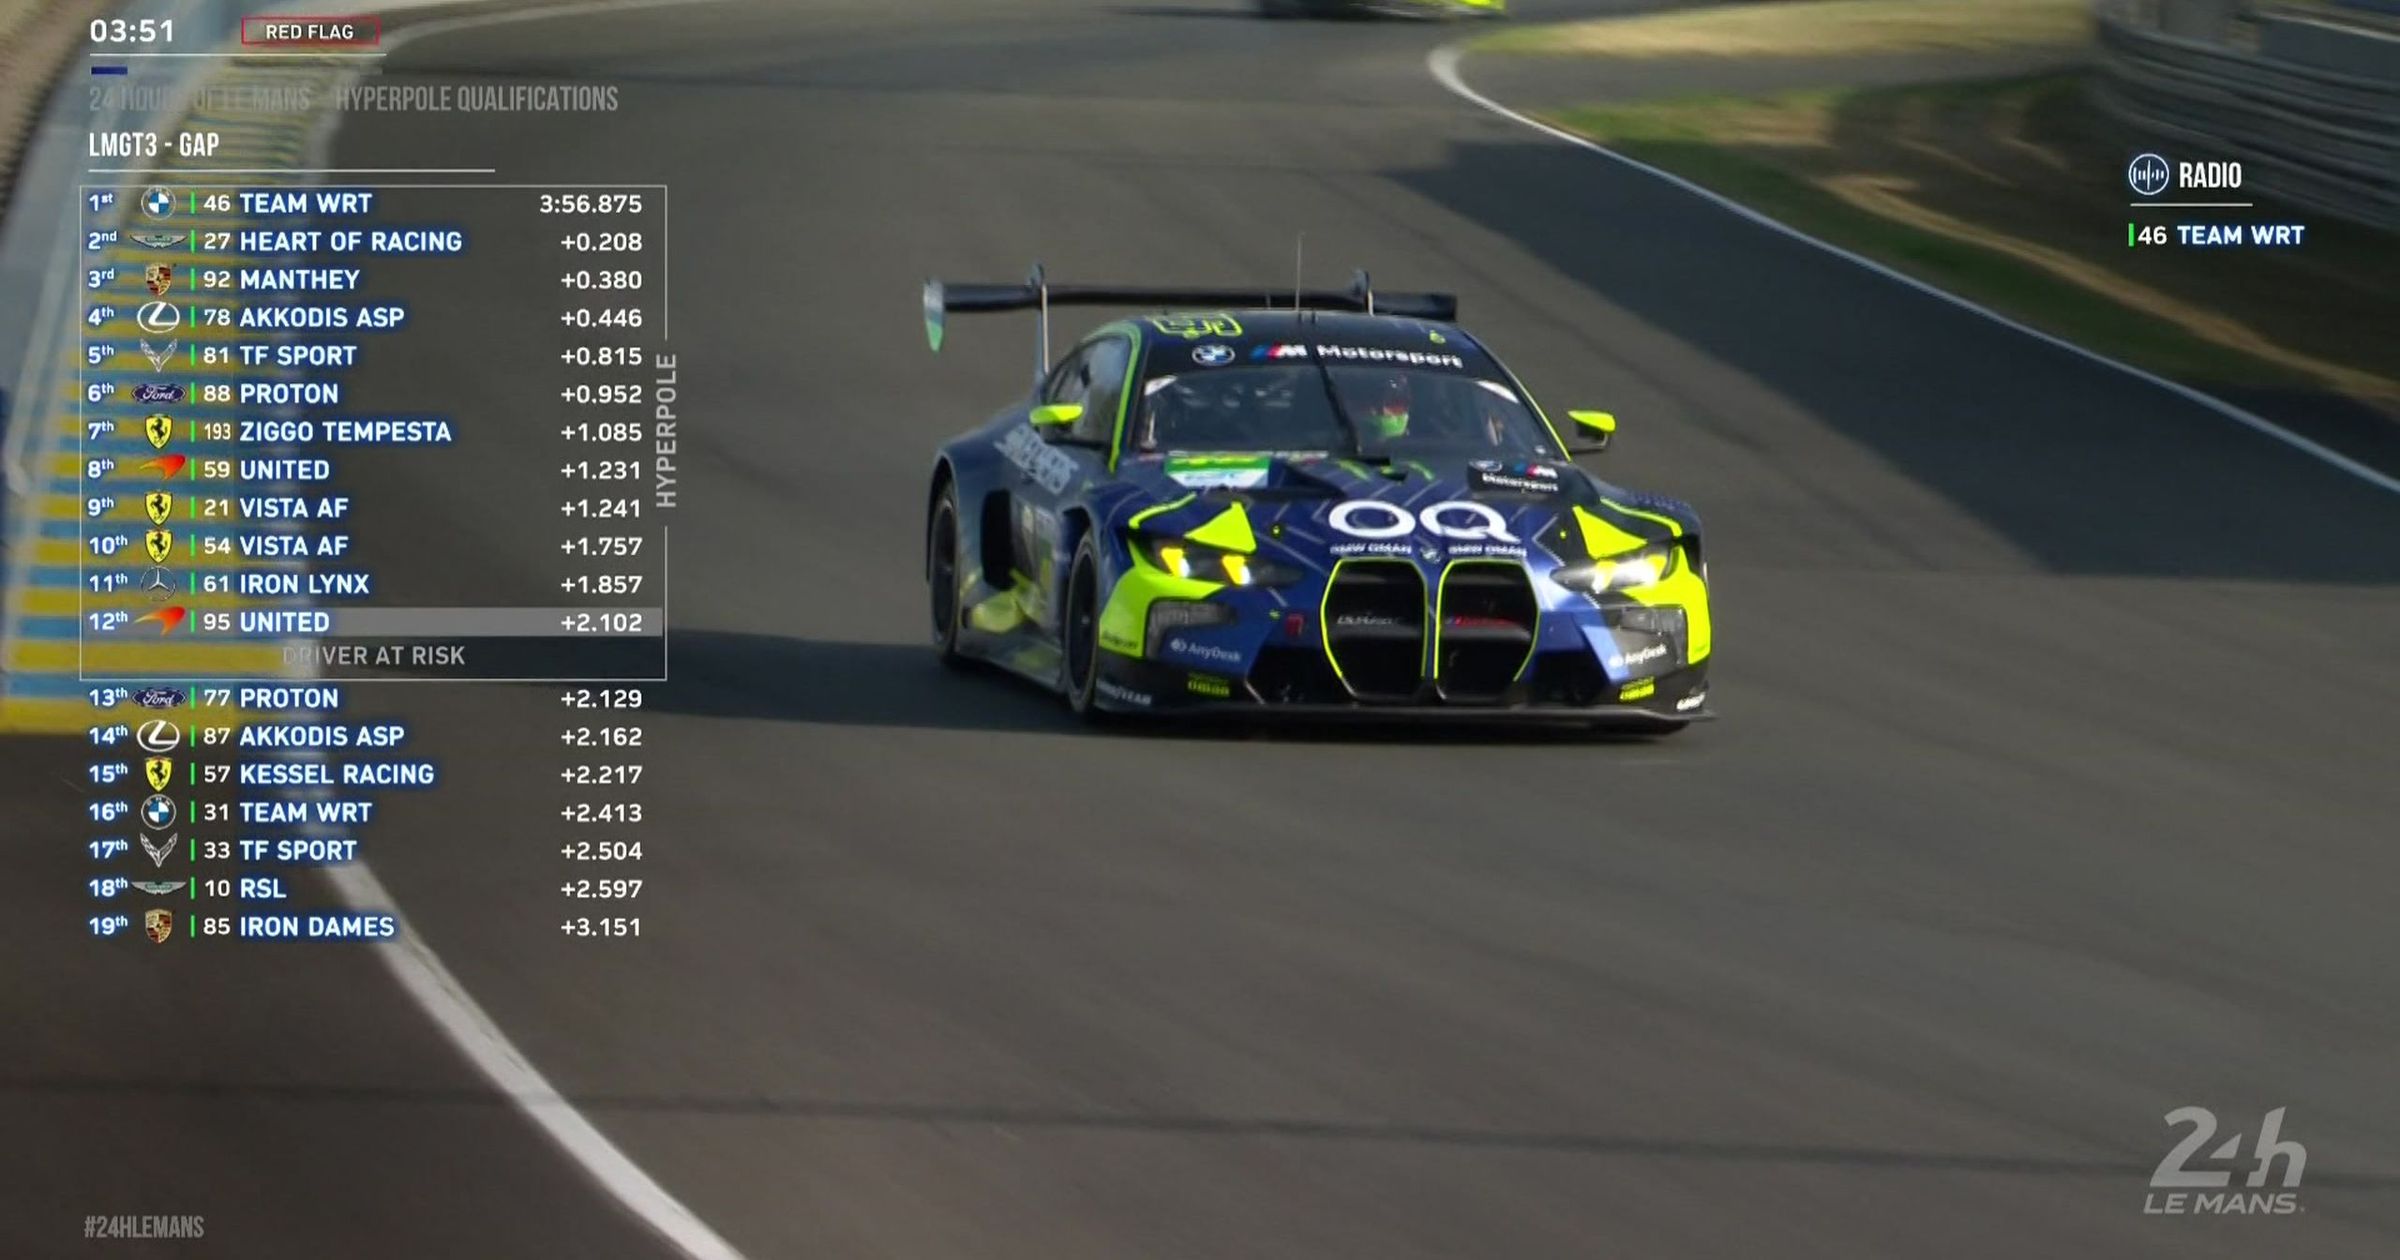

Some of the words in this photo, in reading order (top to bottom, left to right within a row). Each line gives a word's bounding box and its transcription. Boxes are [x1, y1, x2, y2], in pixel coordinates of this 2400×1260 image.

[1316, 344, 1464, 370] Motorsport
[1328, 499, 1522, 545] OQ
[1187, 642, 1242, 663] AnyDesk
